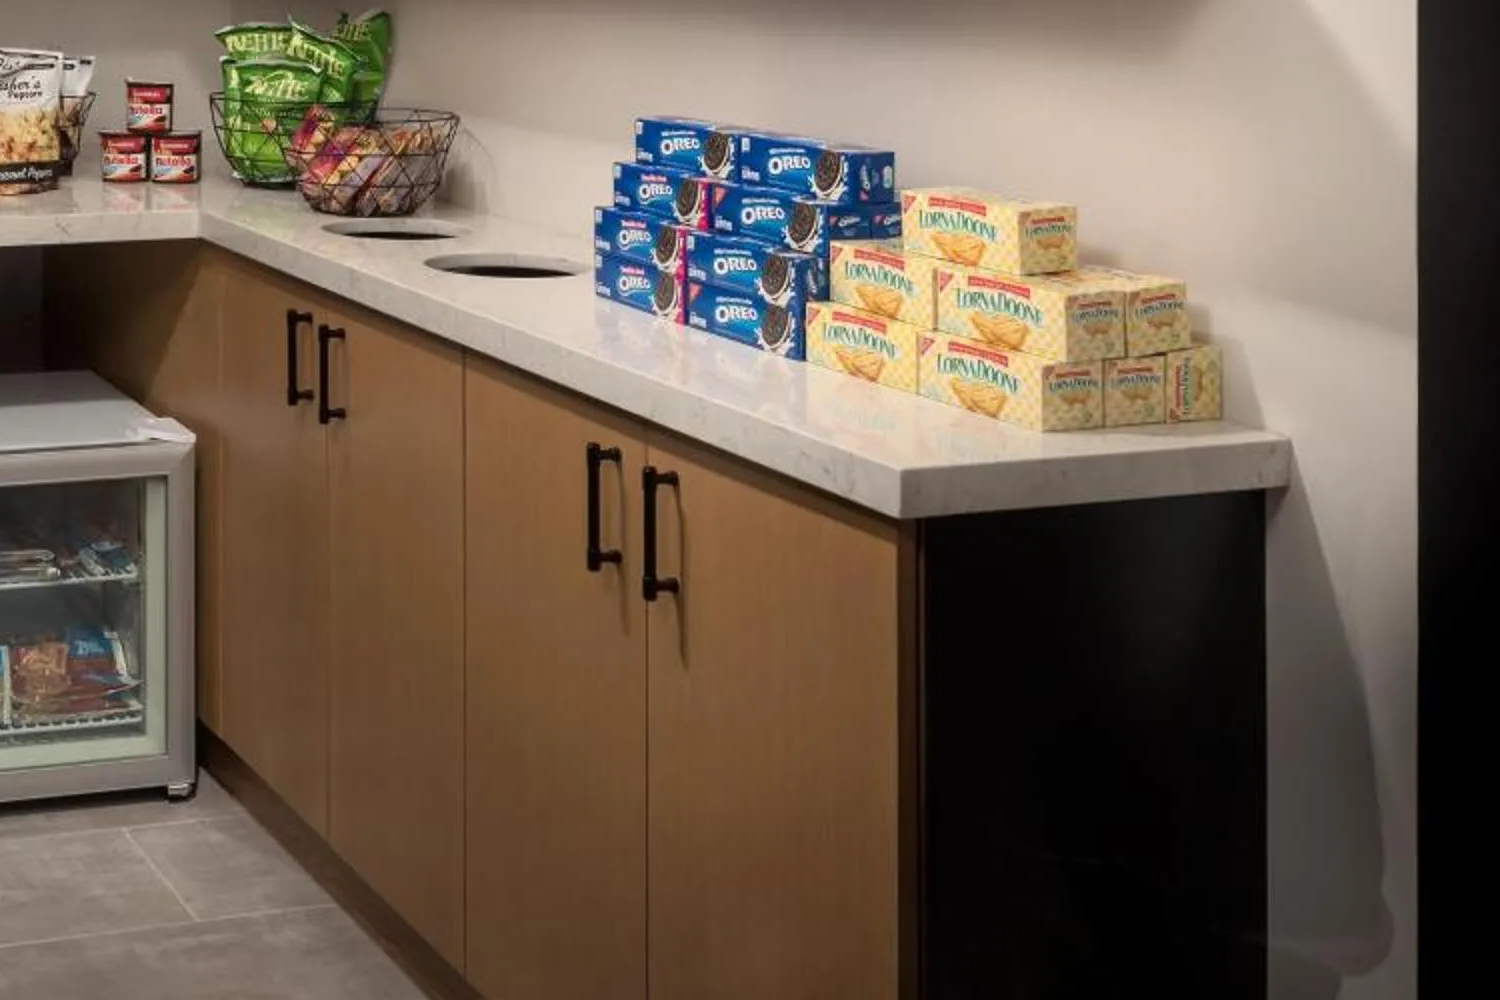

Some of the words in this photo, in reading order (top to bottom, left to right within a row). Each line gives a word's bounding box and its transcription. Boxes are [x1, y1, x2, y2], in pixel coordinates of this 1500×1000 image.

[661, 137, 700, 155] OREO
[768, 154, 812, 176] OREO
[639, 182, 673, 200] OREO
[741, 206, 786, 226] OREO
[619, 228, 652, 245] OREO
[713, 256, 758, 276] OREO
[619, 275, 651, 293] OREO
[715, 305, 759, 324] OREO
